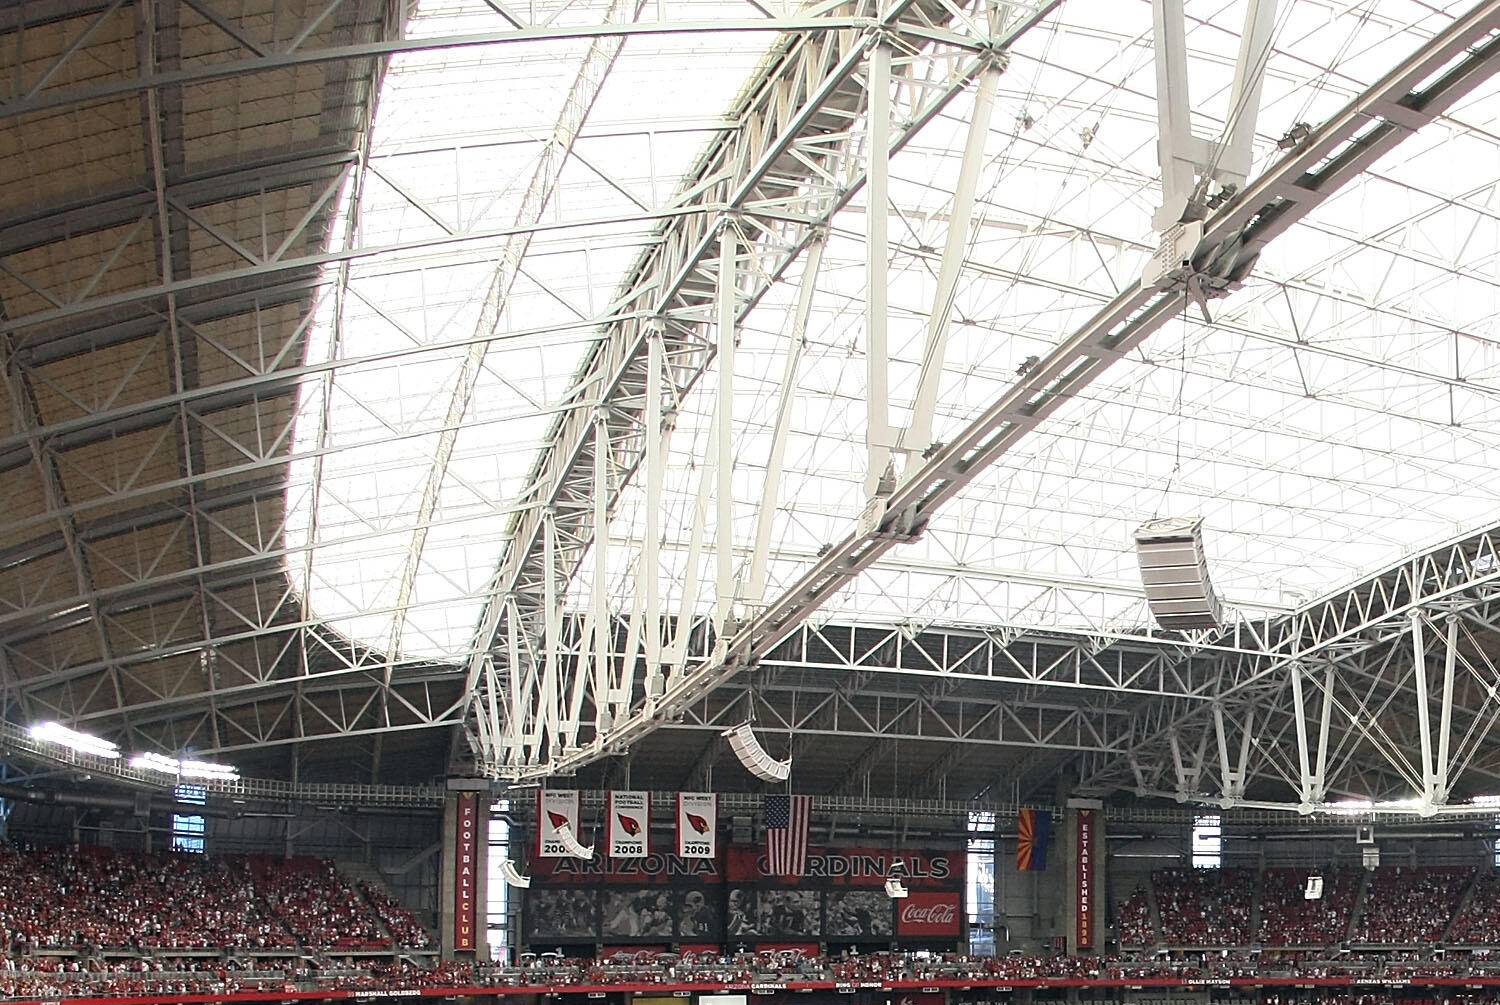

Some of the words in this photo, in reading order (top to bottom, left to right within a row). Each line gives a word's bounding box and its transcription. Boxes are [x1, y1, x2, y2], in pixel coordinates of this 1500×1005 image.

[462, 808, 471, 899] FOOTBALL
[544, 845, 570, 853] 200
[615, 846, 643, 854] 2008
[552, 853, 717, 875] ARIZONA
[757, 855, 950, 878] CRDINALS
[902, 904, 958, 924] Coca-Cola
